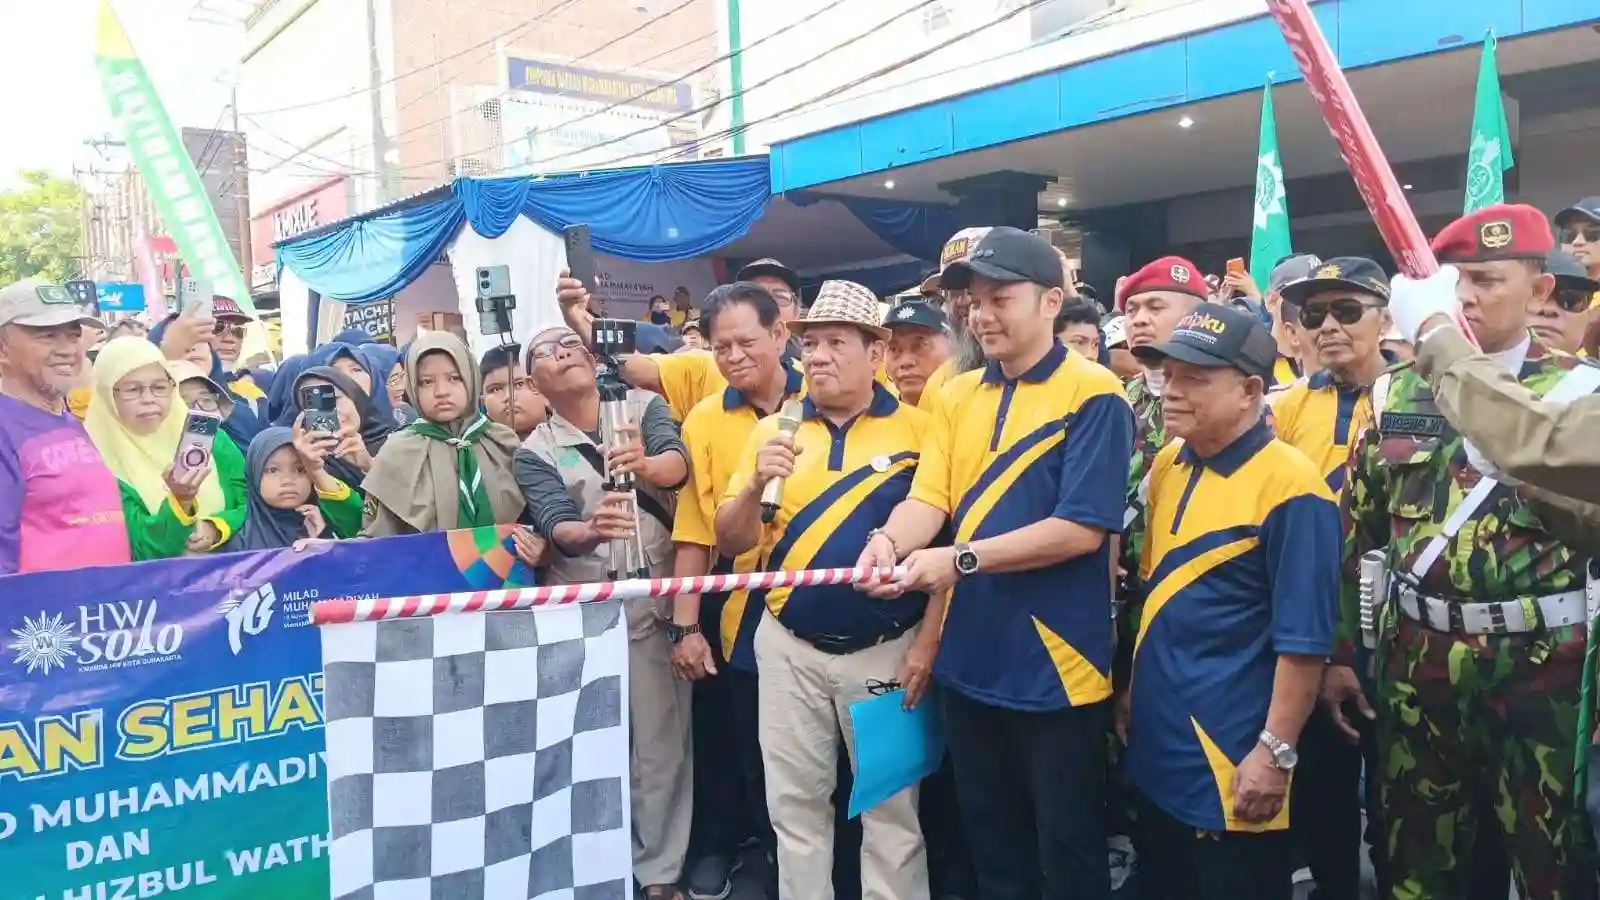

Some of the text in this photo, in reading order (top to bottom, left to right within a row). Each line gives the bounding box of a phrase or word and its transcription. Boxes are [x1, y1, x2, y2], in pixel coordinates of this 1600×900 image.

[283, 588, 319, 602] MILAD
[78, 599, 143, 634] HW
[66, 828, 151, 871] DAN
